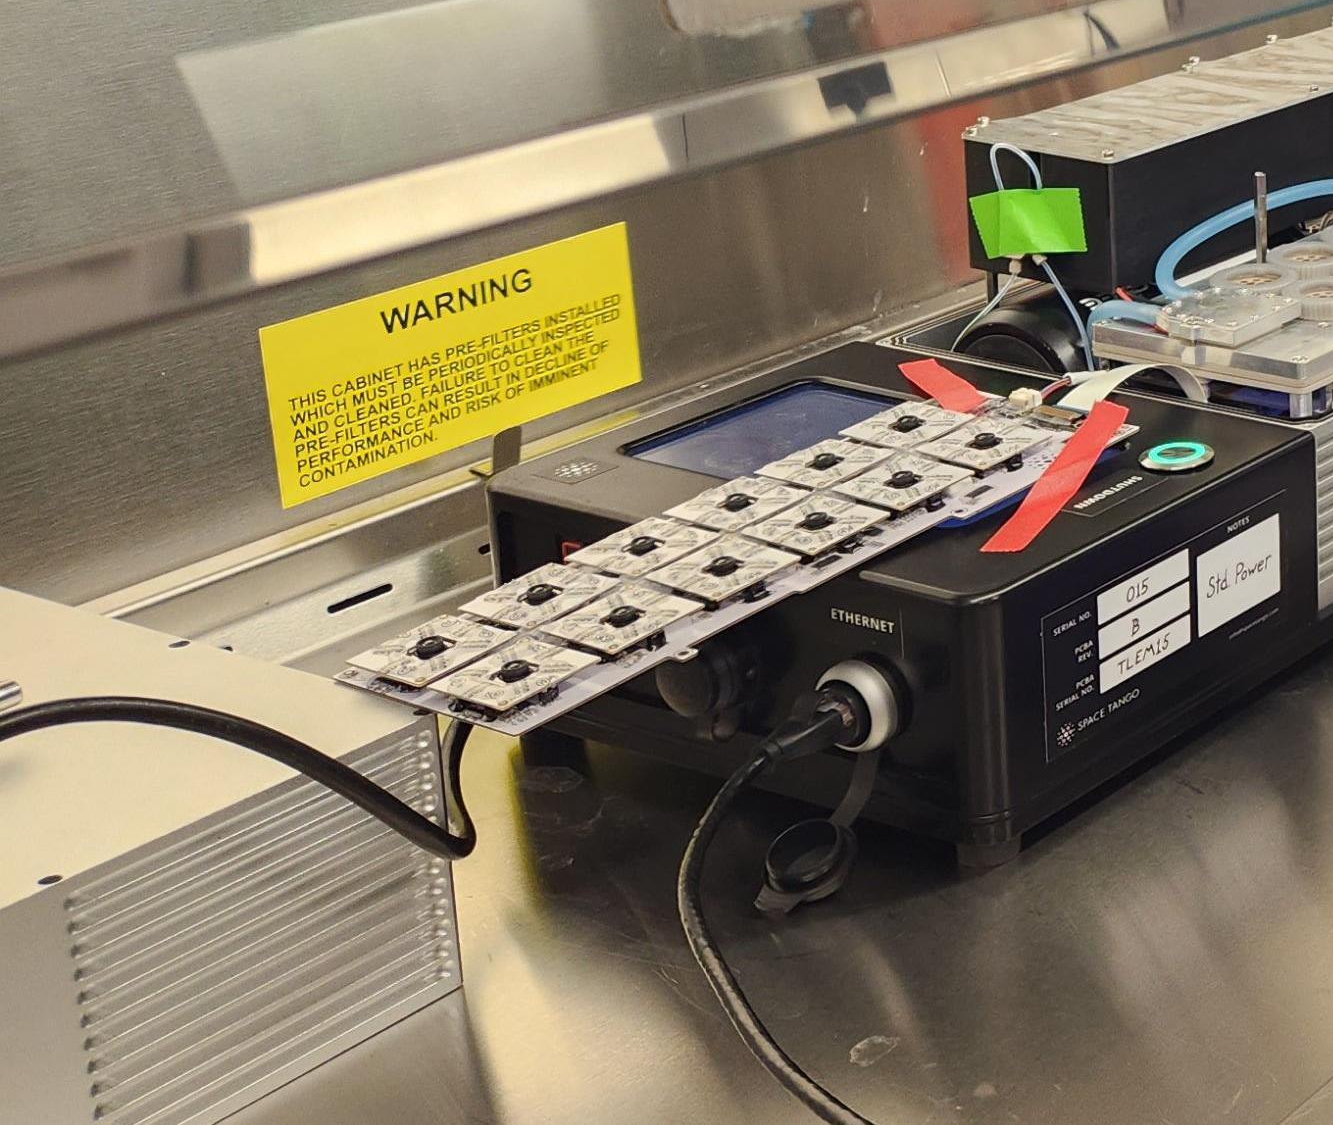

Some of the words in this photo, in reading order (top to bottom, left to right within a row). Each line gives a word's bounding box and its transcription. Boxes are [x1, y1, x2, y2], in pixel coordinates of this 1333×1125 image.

[380, 268, 532, 334] WARNING
[288, 389, 327, 412] THIS
[332, 363, 404, 397] CABINET
[408, 352, 441, 373] HAS
[445, 319, 541, 360] PRE-FILTERS
[544, 293, 621, 327] INSTALLED
[290, 398, 347, 427] WHICH
[352, 381, 398, 407] MUST
[403, 373, 424, 391] BE
[428, 336, 537, 381] PERIODICALLY
[541, 308, 620, 344] INSPECTED
[293, 421, 329, 443] AND
[334, 392, 416, 428] CLEANED.
[421, 368, 487, 398] FAILURE
[489, 359, 510, 376] TO
[513, 342, 563, 367] CLEAN
[567, 330, 595, 348] THE
[295, 412, 401, 458] PRE-FILTERS
[405, 398, 439, 420] CAN
[443, 377, 503, 407] RESULT
[507, 369, 522, 386] IN
[525, 348, 587, 379] DECLINE
[589, 339, 609, 356] OF
[297, 418, 425, 473] PERFORMANCE
[428, 406, 461, 427] AND
[466, 391, 503, 415] RISK
[505, 383, 526, 400] OF
[529, 357, 599, 392] IMMINENT
[299, 430, 438, 488] CONTAMINATION.
[1073, 475, 1143, 509] SHUTDOWN
[1227, 516, 1250, 534] NOTES
[1235, 554, 1272, 585] Power
[1126, 577, 1150, 603] 015
[830, 607, 895, 634] ETHERNET
[1052, 619, 1077, 637] SERIAL
[1078, 611, 1092, 622] NO.
[1130, 617, 1140, 638] B
[1074, 640, 1094, 656] PCBA
[1117, 632, 1171, 675] TLEM15
[1075, 674, 1095, 690] PCBA
[1055, 693, 1080, 712] SERIAL
[1077, 707, 1105, 732] SPACE
[1107, 688, 1140, 714] TANGO
